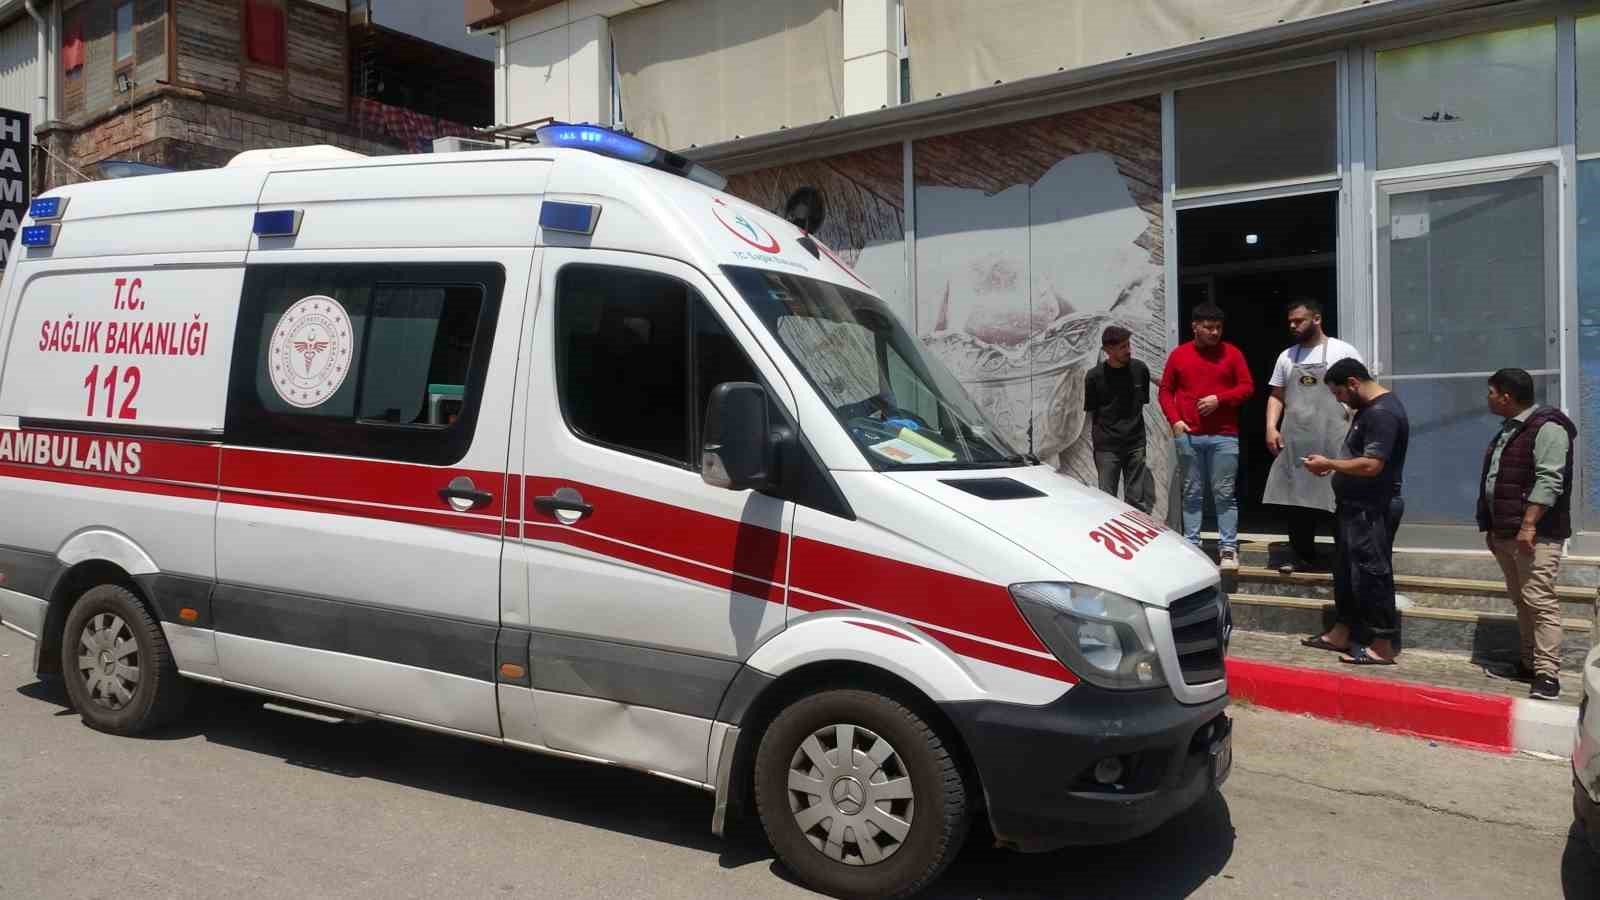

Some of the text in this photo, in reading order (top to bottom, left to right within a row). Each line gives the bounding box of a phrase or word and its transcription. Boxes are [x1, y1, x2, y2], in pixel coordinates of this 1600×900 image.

[113, 277, 145, 310] T.C.
[39, 312, 209, 356] SAĞLIK BAKANLIĞI
[83, 364, 142, 420] 112
[0, 431, 142, 475] AMBULANS
